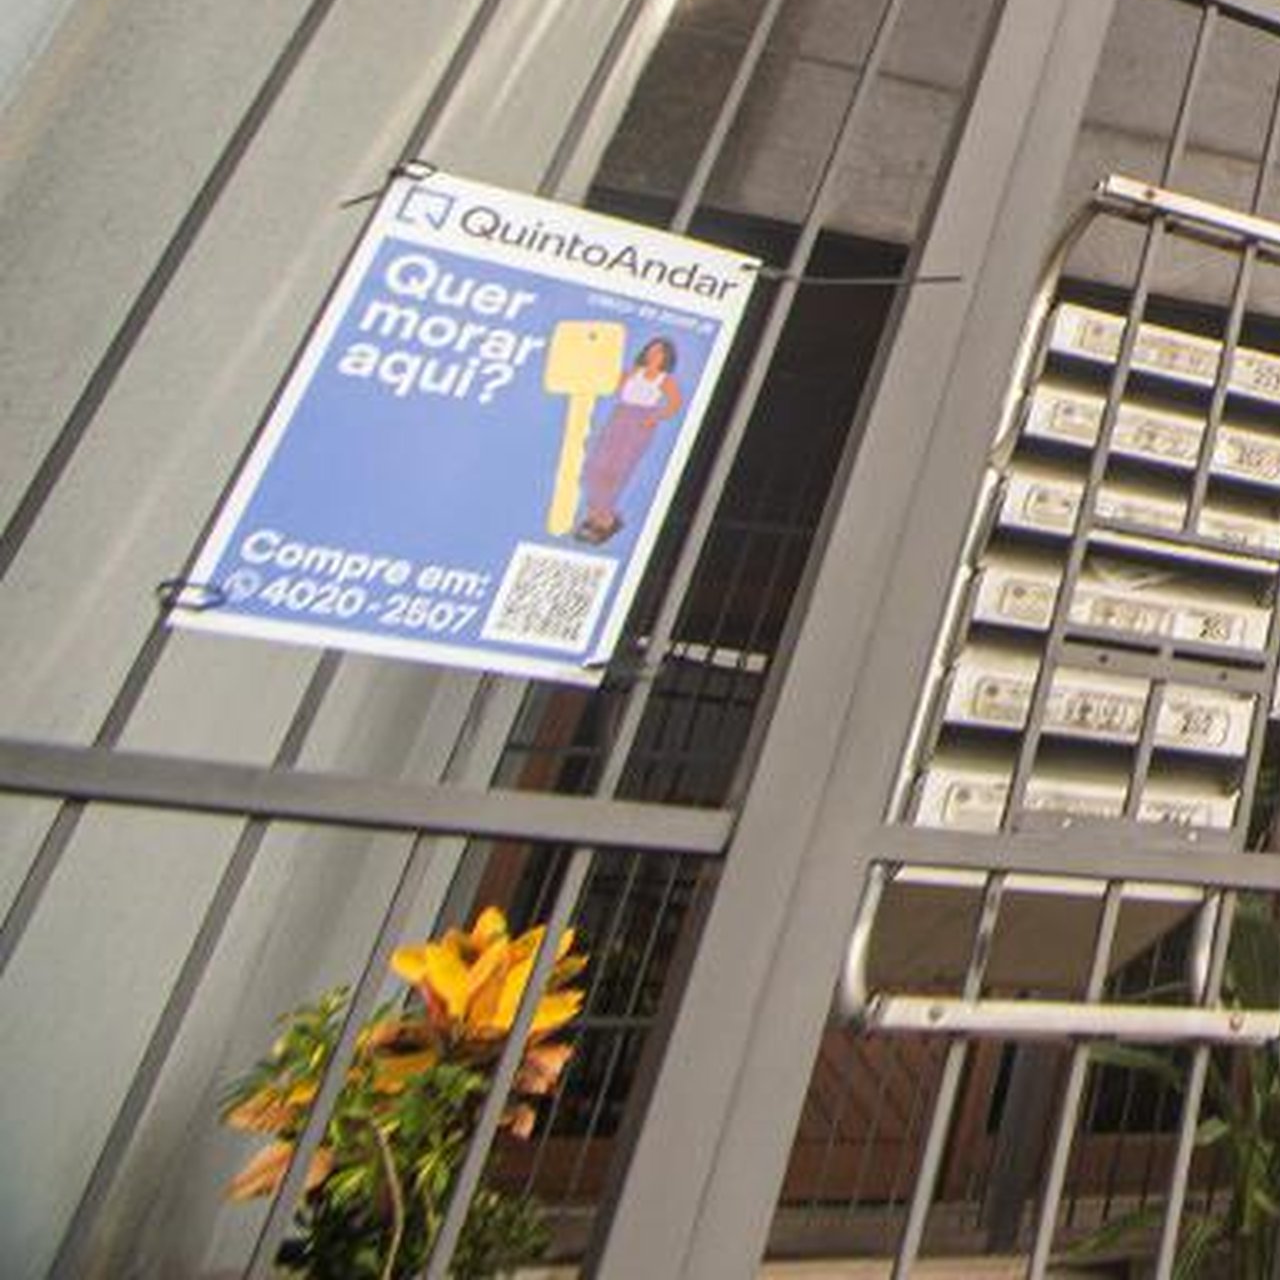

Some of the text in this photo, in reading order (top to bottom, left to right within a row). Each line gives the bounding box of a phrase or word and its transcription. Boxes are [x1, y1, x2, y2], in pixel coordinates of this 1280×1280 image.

[384, 253, 537, 321] Quer
[459, 204, 740, 303] QuintoAndar
[358, 294, 545, 368] morar
[337, 336, 516, 406] aqui?
[239, 527, 410, 586] Compre
[413, 562, 490, 595] em:
